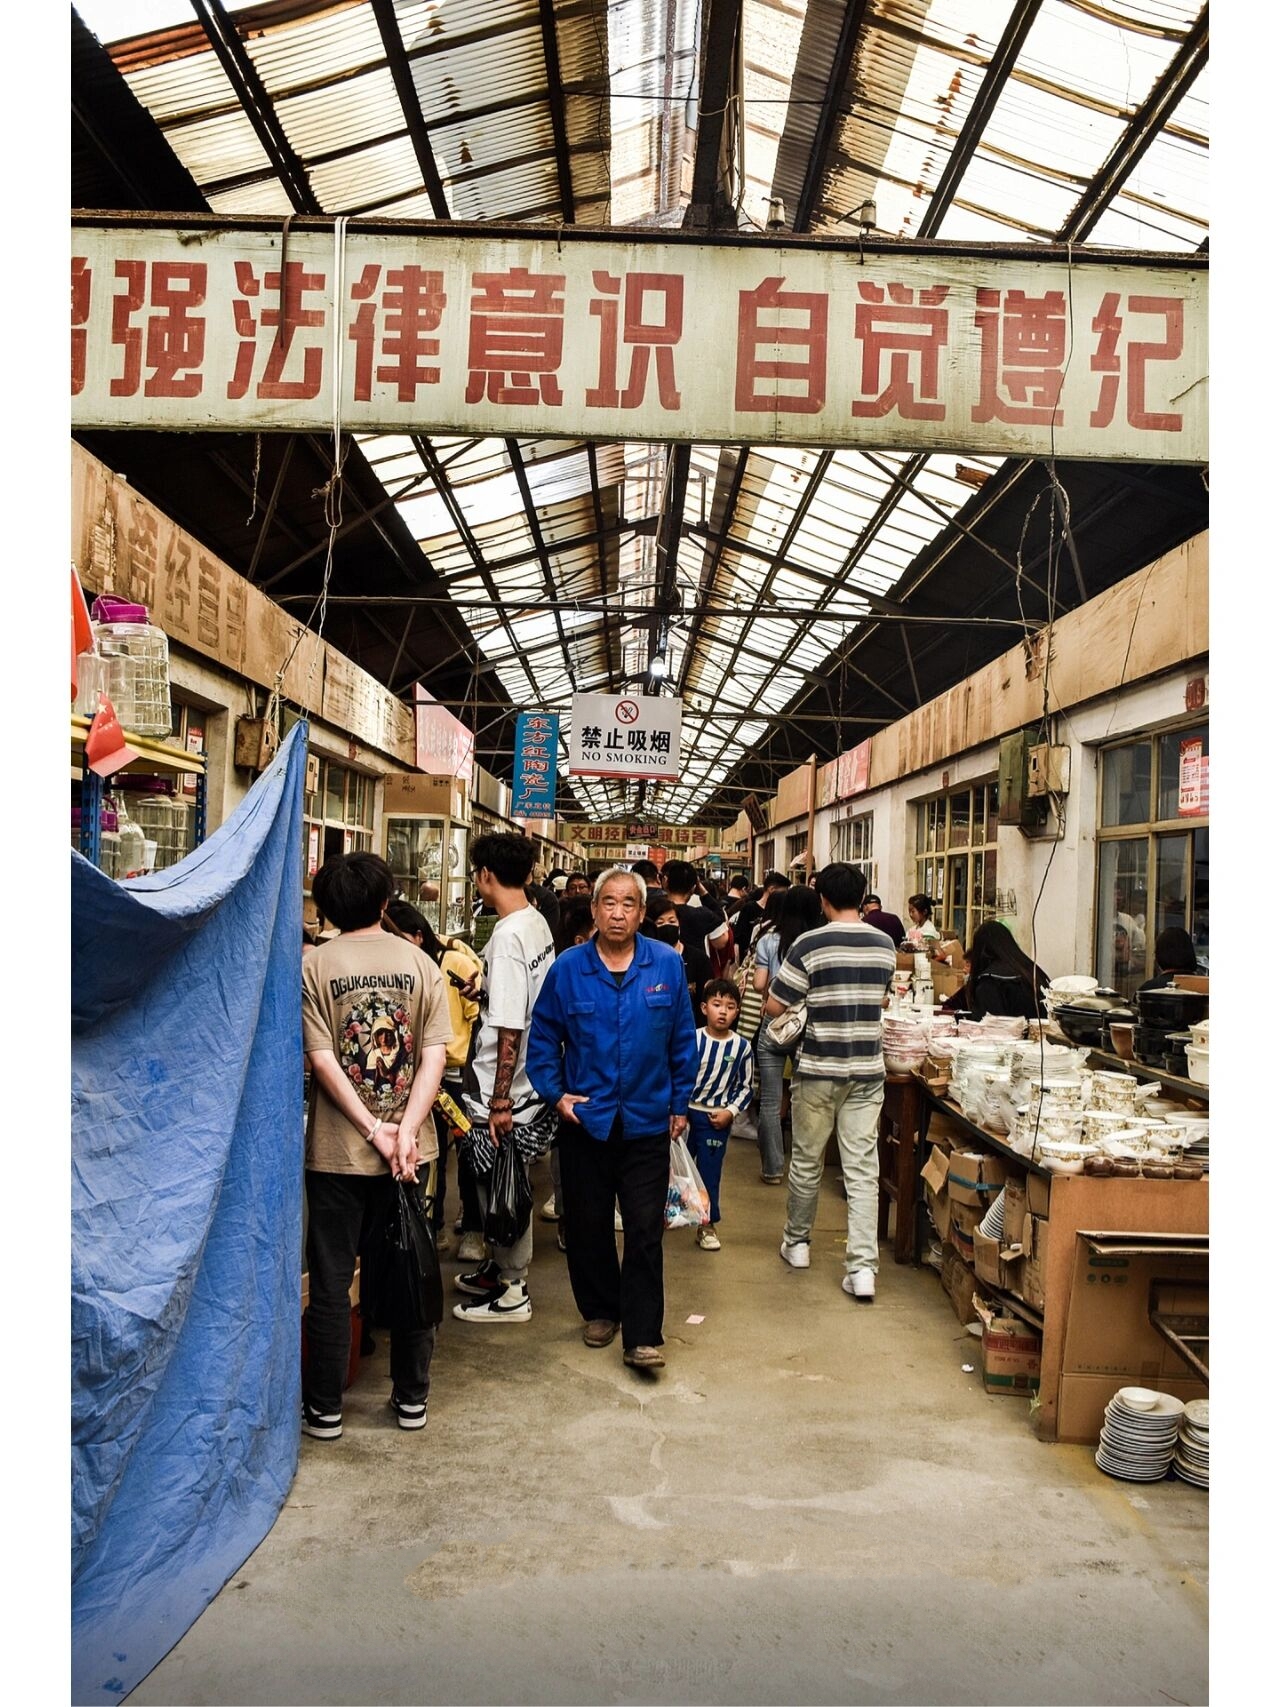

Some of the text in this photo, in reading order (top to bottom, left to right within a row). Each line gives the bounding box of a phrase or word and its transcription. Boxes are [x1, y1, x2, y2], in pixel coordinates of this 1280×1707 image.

[581, 725, 671, 754] 禁止吸烟
[581, 751, 667, 765] NO SMOKING
